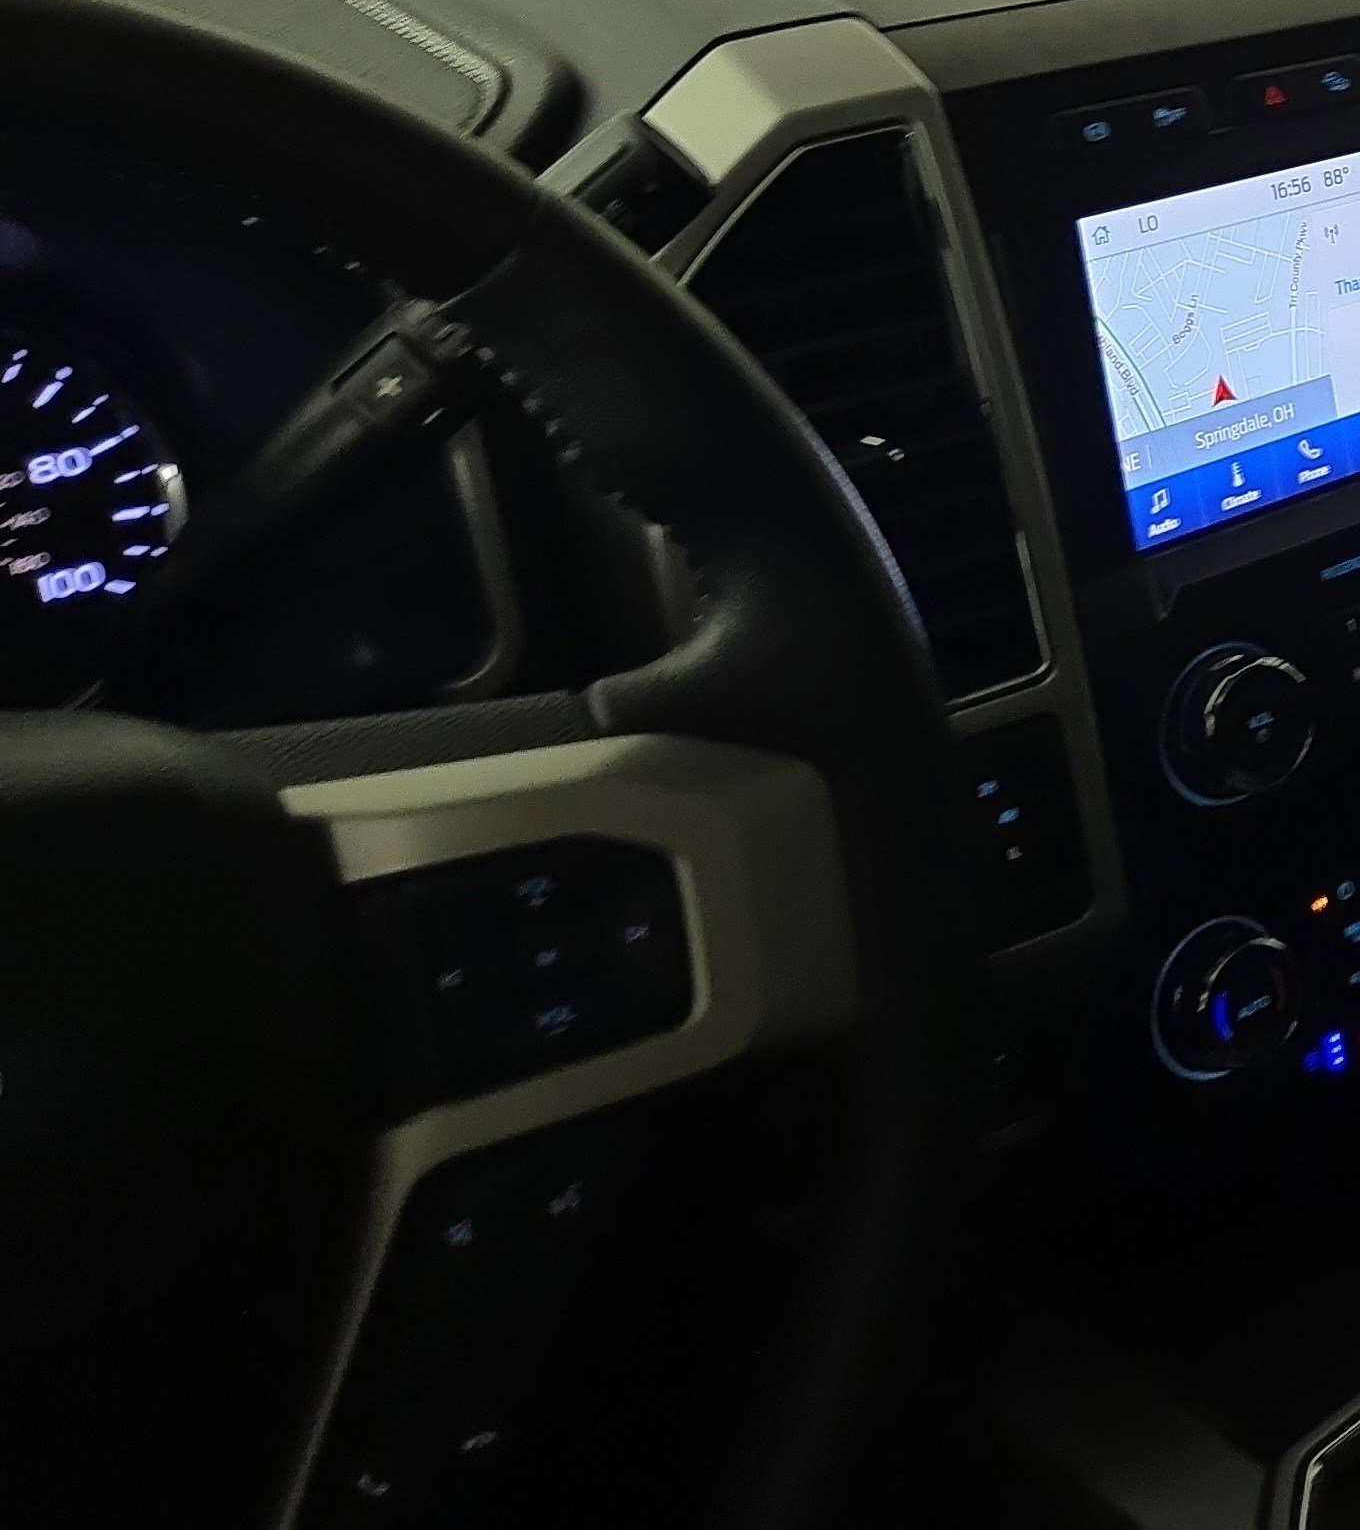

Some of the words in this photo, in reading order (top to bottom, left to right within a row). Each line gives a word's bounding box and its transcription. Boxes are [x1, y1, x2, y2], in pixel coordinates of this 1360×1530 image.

[1138, 215, 1158, 234] LO
[1270, 176, 1312, 200] 16:56
[1194, 416, 1272, 450] Springdale,
[1272, 403, 1295, 422] OH
[28, 447, 92, 484] 80
[37, 562, 106, 603] 100
